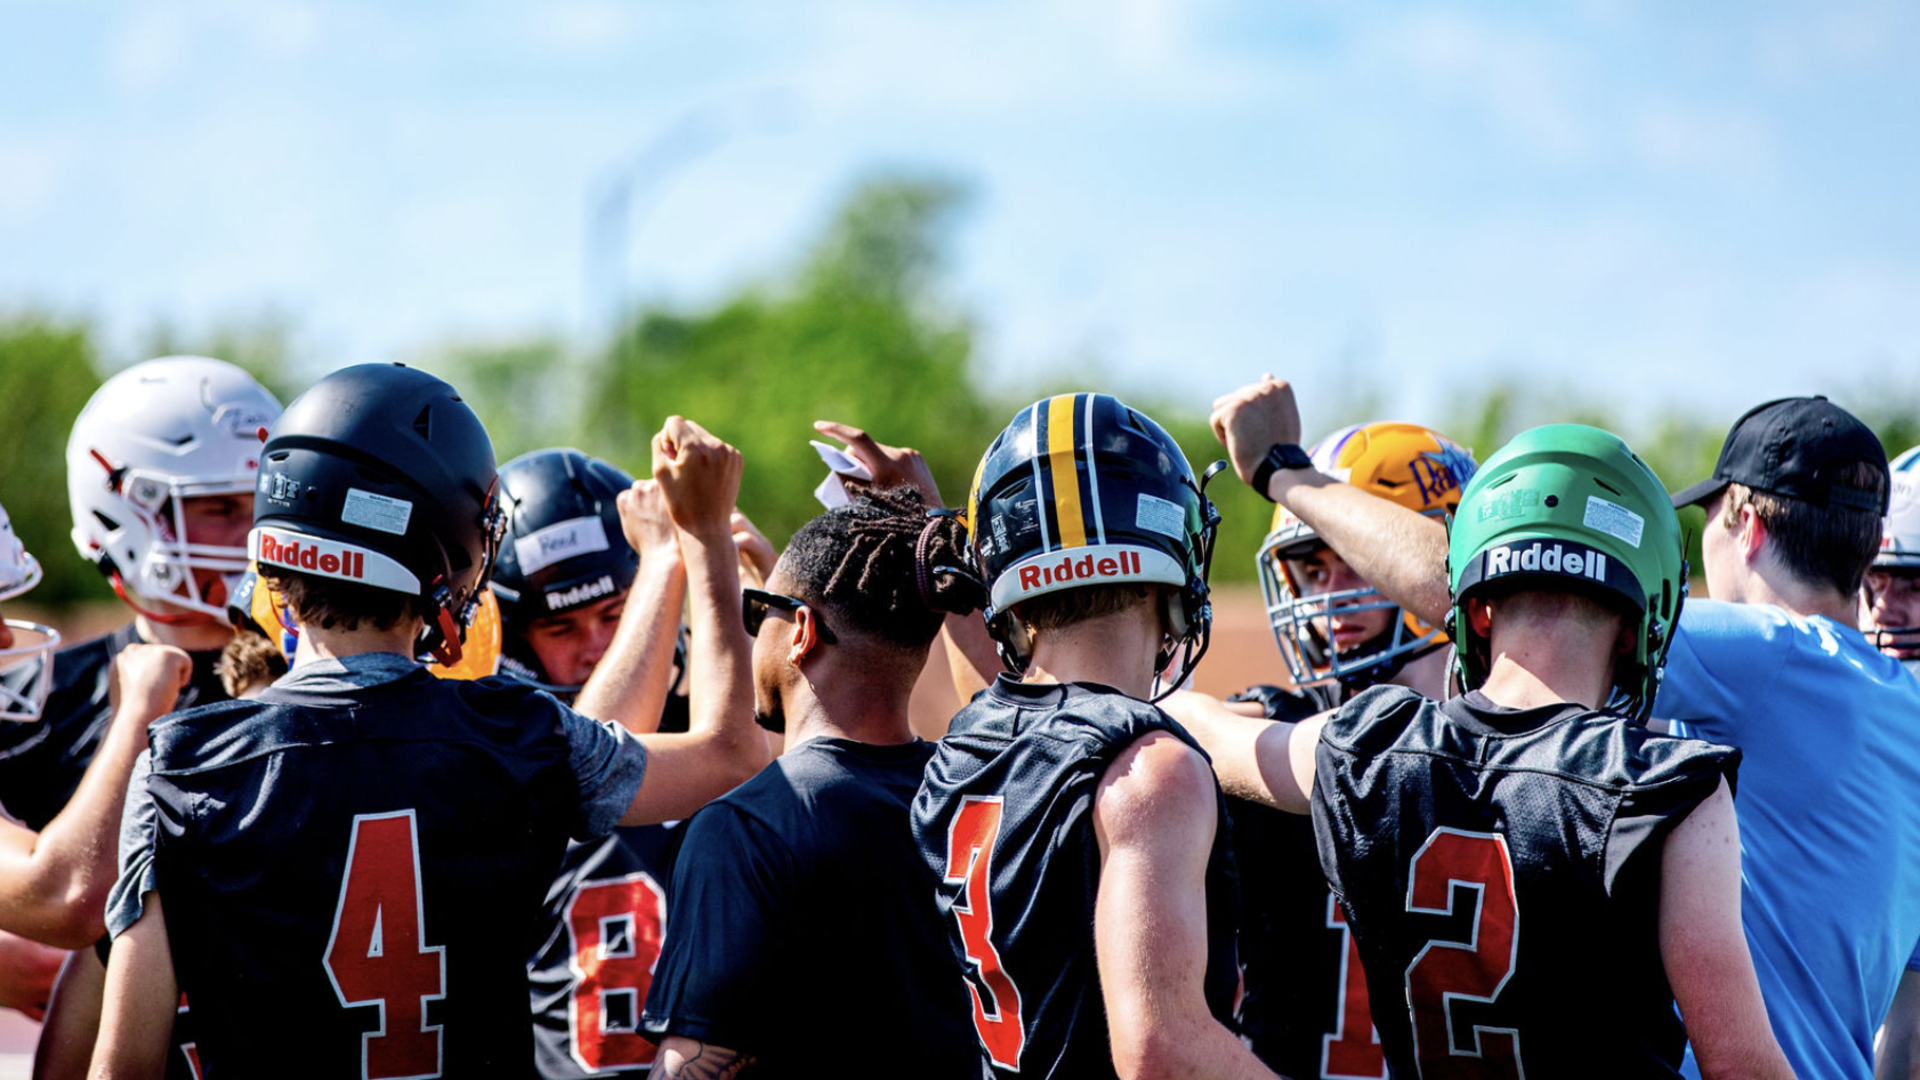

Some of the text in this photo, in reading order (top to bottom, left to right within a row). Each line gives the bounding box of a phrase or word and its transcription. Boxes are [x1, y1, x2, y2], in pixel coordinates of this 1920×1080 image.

[260, 533, 364, 579] Riddell
[546, 575, 615, 610] Riddell
[1018, 551, 1142, 592] Riddell
[1488, 543, 1606, 582] Riddell
[322, 808, 446, 1080] 4
[563, 871, 667, 1075] 8
[943, 795, 1026, 1073] 3
[1405, 826, 1525, 1080] 2
